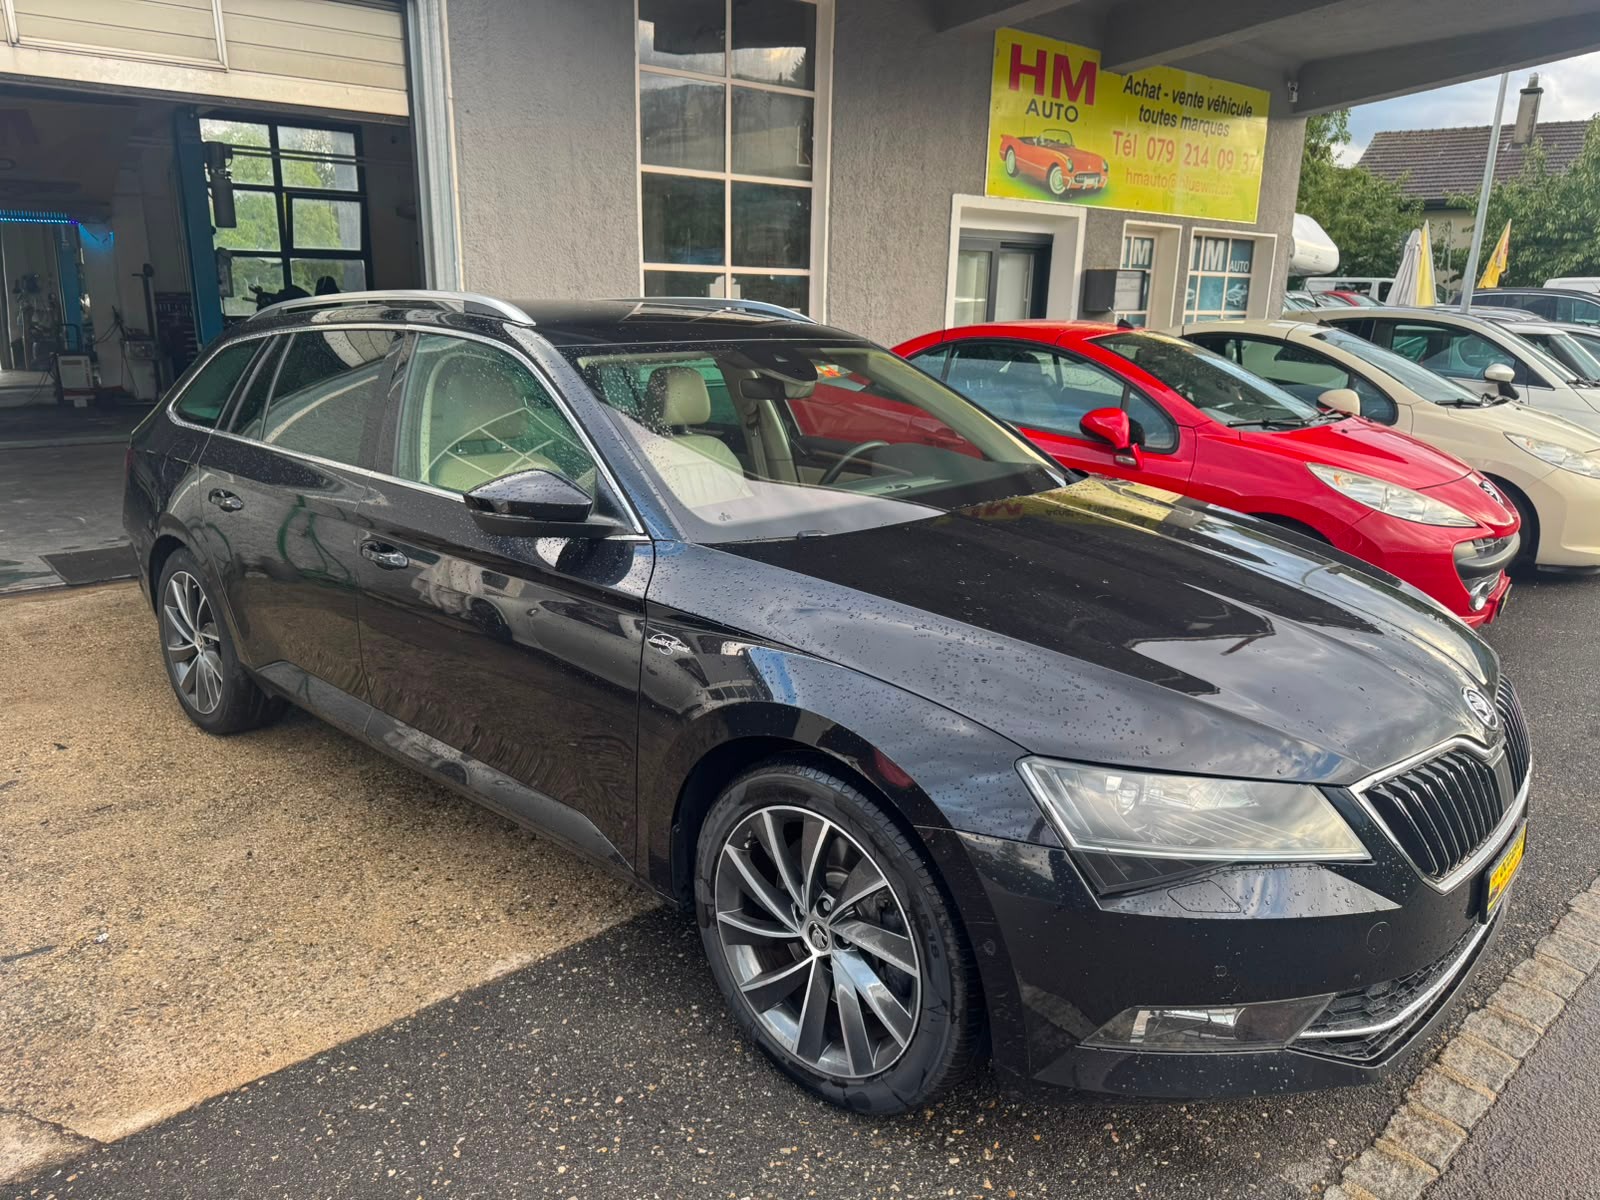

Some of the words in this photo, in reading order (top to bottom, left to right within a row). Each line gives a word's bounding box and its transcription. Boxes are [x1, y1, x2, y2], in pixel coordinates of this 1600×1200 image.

[1009, 43, 1097, 106] HM
[1025, 98, 1079, 123] AUTO
[1123, 75, 1162, 100] Achat
[1172, 89, 1204, 109] vente
[1207, 94, 1253, 118] véhicule
[1139, 104, 1178, 127] toutes
[1180, 116, 1230, 137] marques
[1113, 130, 1137, 158] Tél
[1147, 136, 1175, 163] 079
[1183, 143, 1209, 168] 214
[1217, 149, 1234, 171] 09
[1230, 260, 1250, 273] AUTO
